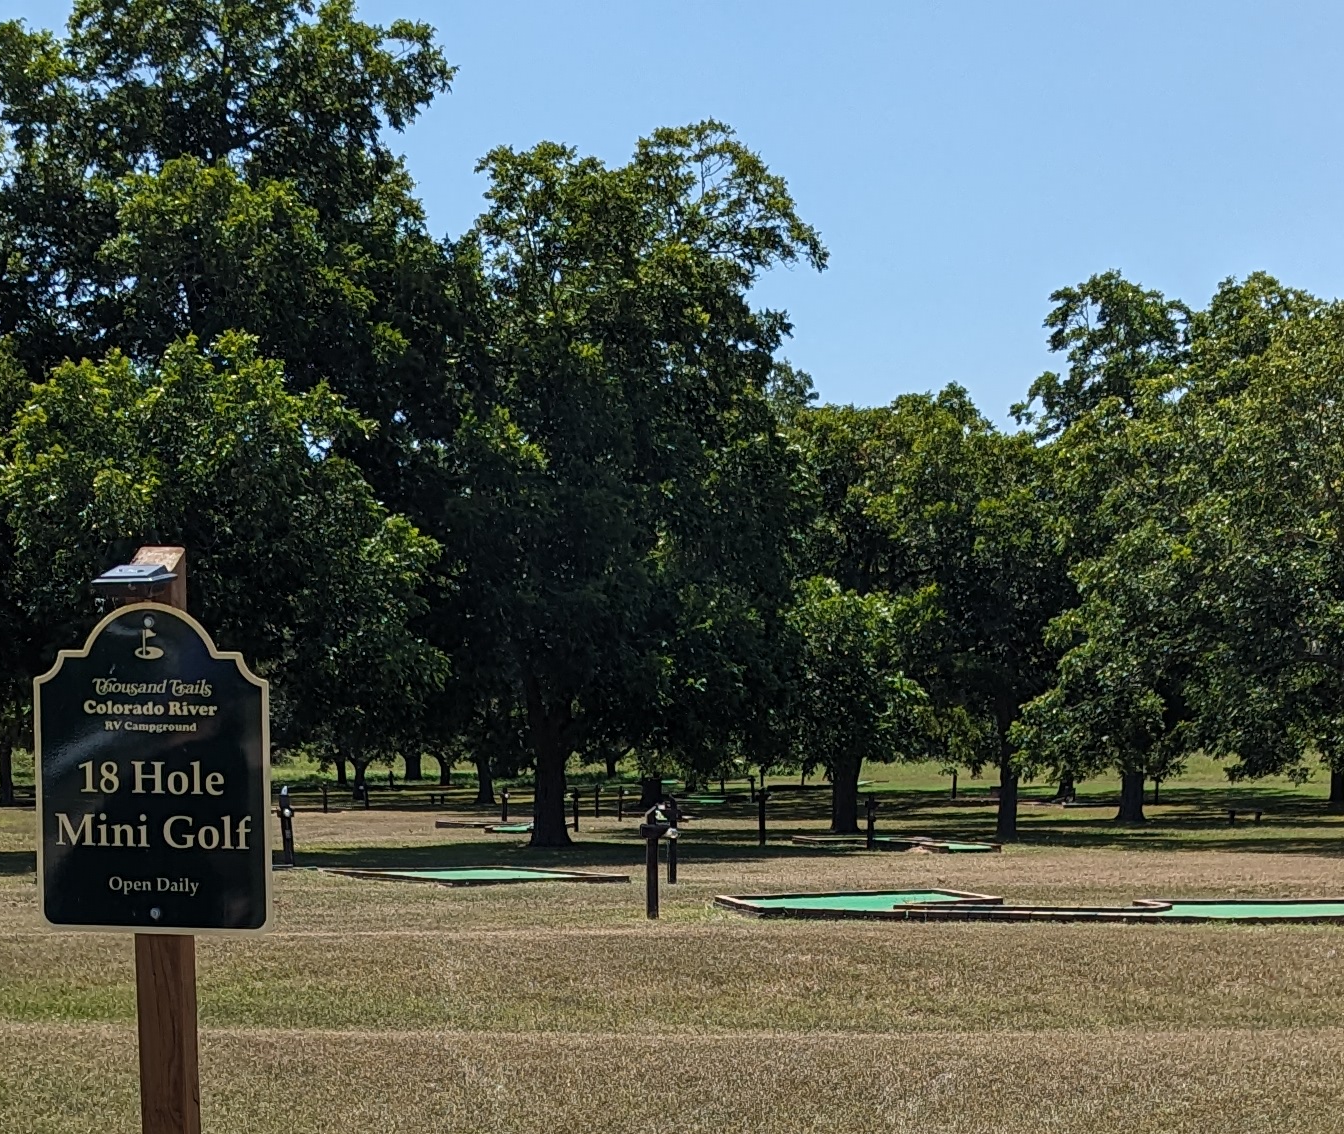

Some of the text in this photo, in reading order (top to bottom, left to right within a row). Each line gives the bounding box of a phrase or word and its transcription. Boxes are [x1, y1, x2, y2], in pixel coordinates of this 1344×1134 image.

[92, 678, 212, 697] Thousand Trails
[83, 700, 217, 716] Colorado River
[104, 720, 197, 733] RV Campground
[78, 760, 224, 796] 18 Hole
[55, 812, 252, 850] Mini Golf
[108, 876, 200, 897] Open Daily
